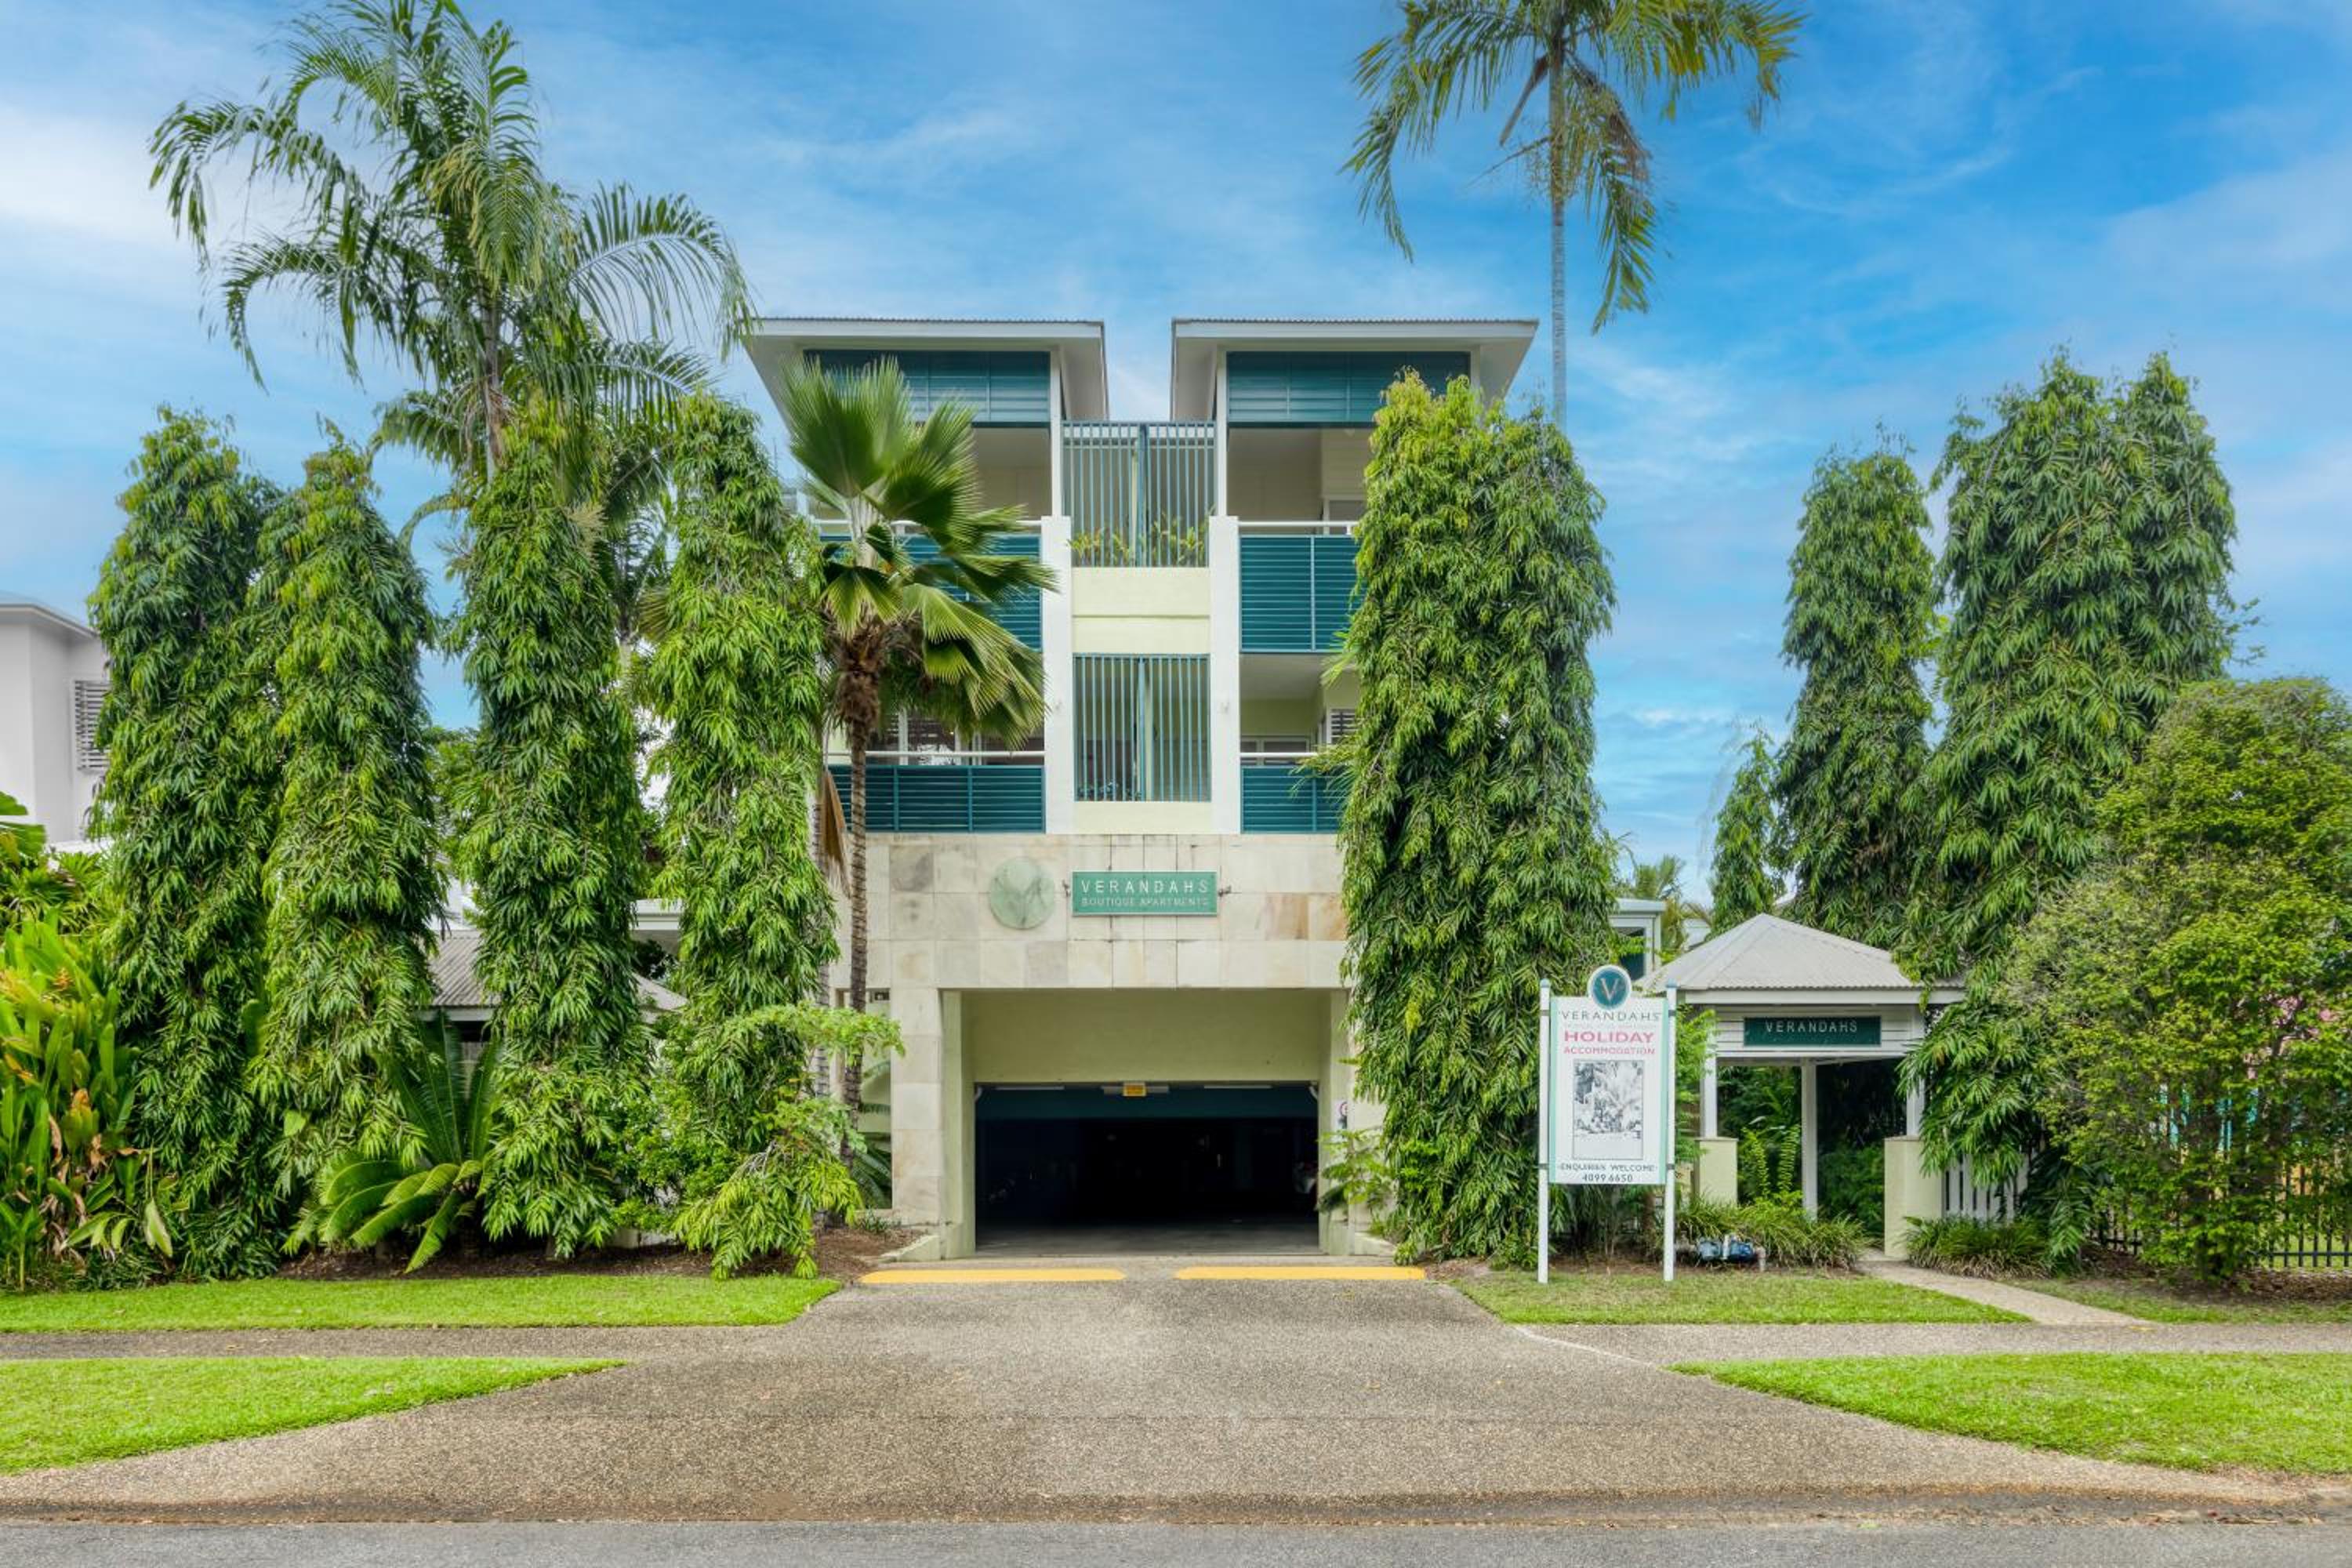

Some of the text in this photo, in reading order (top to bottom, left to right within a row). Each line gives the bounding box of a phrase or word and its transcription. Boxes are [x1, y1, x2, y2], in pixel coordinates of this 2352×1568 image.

[1081, 880, 1208, 894] VERANDAHS
[1081, 898, 1208, 906] BOUTIQUE APARTMENTS
[1600, 978, 1619, 1003] V
[1766, 1021, 1857, 1033] VERANDAHS
[1564, 1031, 1654, 1043] HOLIDAY
[1582, 1173, 1633, 1183] 4099 6650
